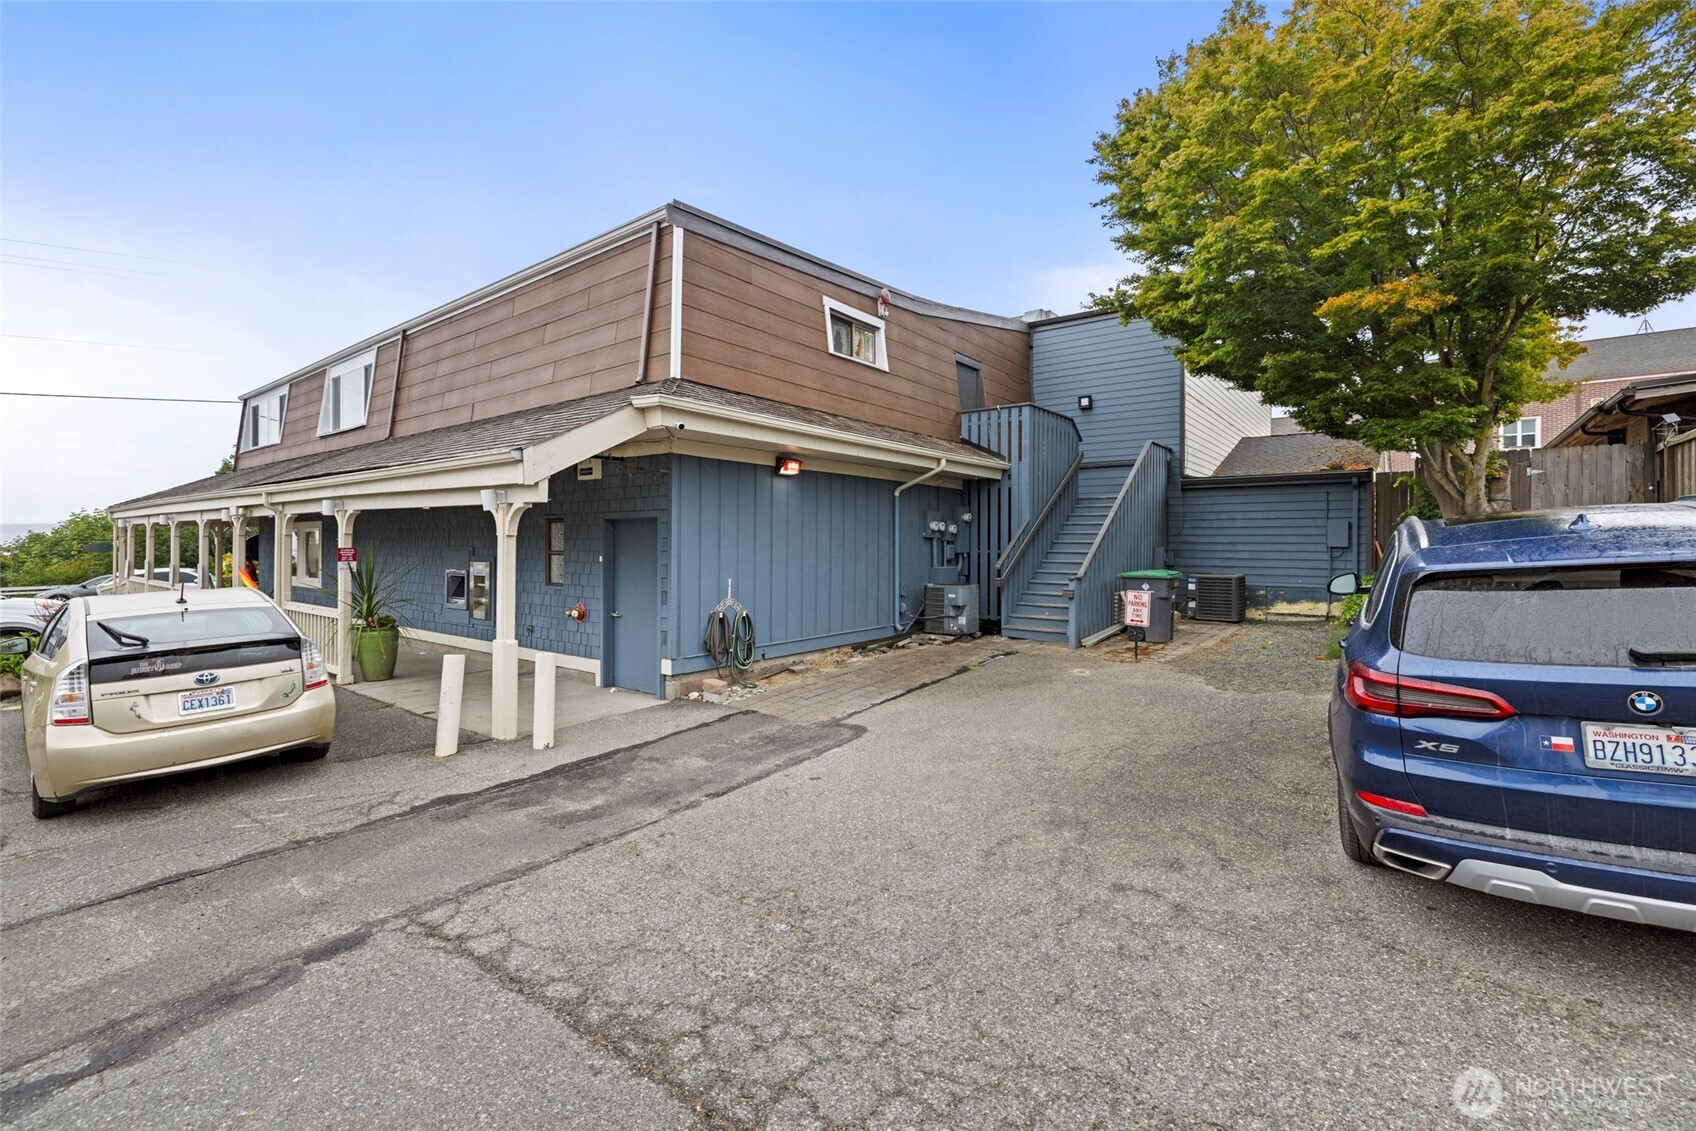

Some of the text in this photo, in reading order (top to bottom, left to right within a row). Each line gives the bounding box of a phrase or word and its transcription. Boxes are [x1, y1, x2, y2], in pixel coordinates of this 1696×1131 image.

[1128, 600, 1147, 608] PARKING
[182, 694, 231, 711] CEX1361
[1592, 731, 1660, 741] WASHINGTON
[1413, 740, 1460, 754] X5
[1614, 763, 1655, 771] CLASSIC
